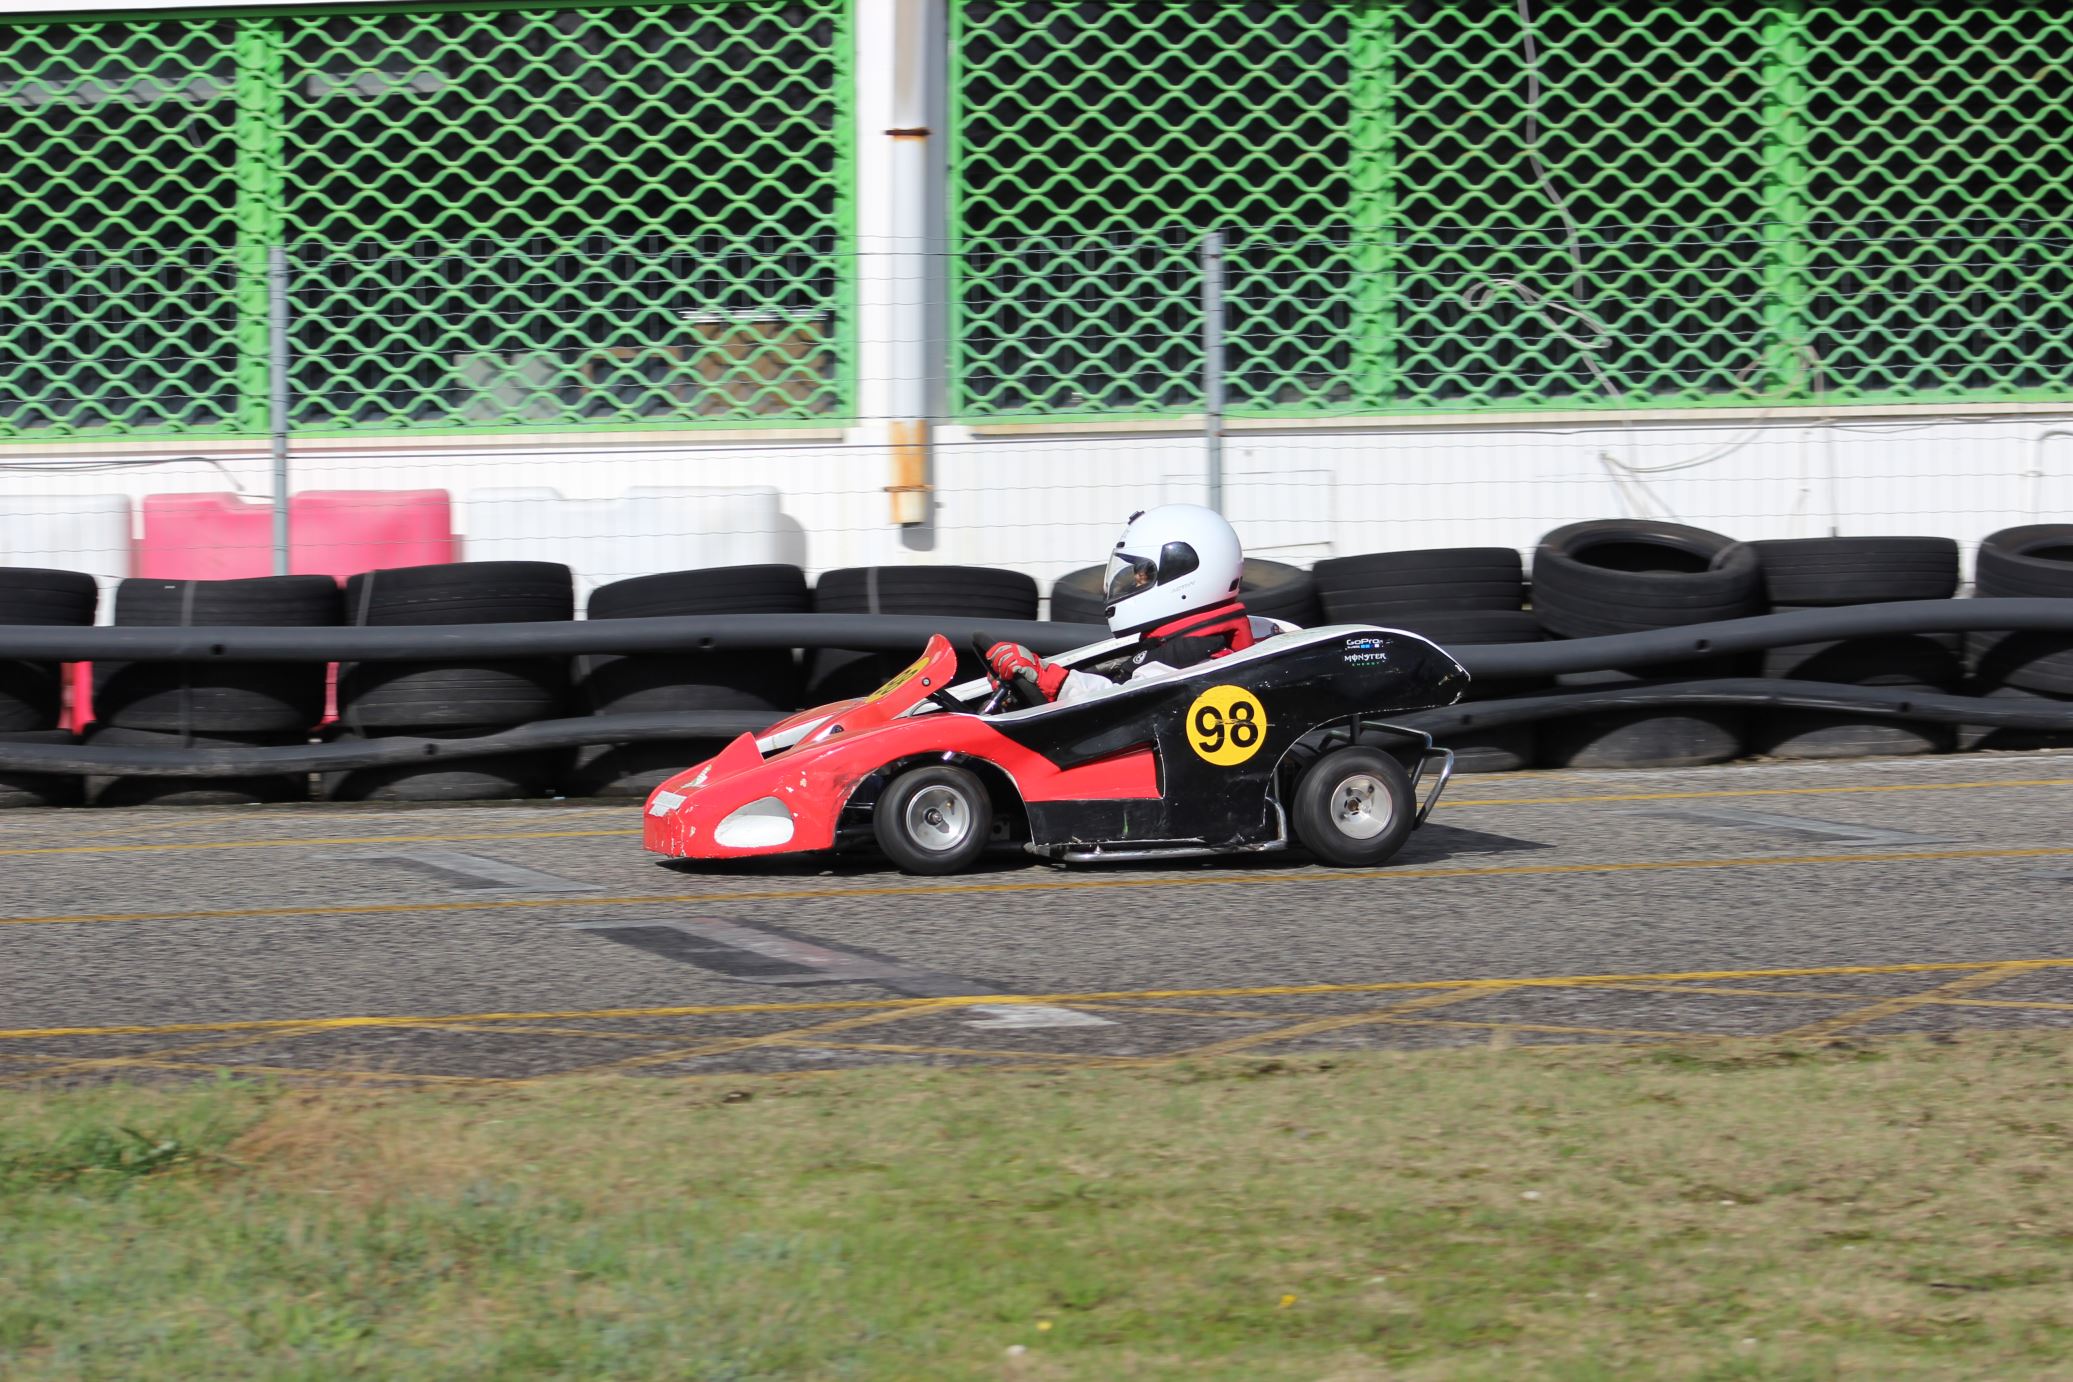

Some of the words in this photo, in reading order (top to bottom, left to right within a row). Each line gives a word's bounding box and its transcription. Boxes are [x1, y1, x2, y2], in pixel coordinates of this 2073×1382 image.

[1346, 638, 1380, 646] GoPro
[1344, 653, 1387, 662] MONSTER
[1195, 701, 1259, 753] 98
